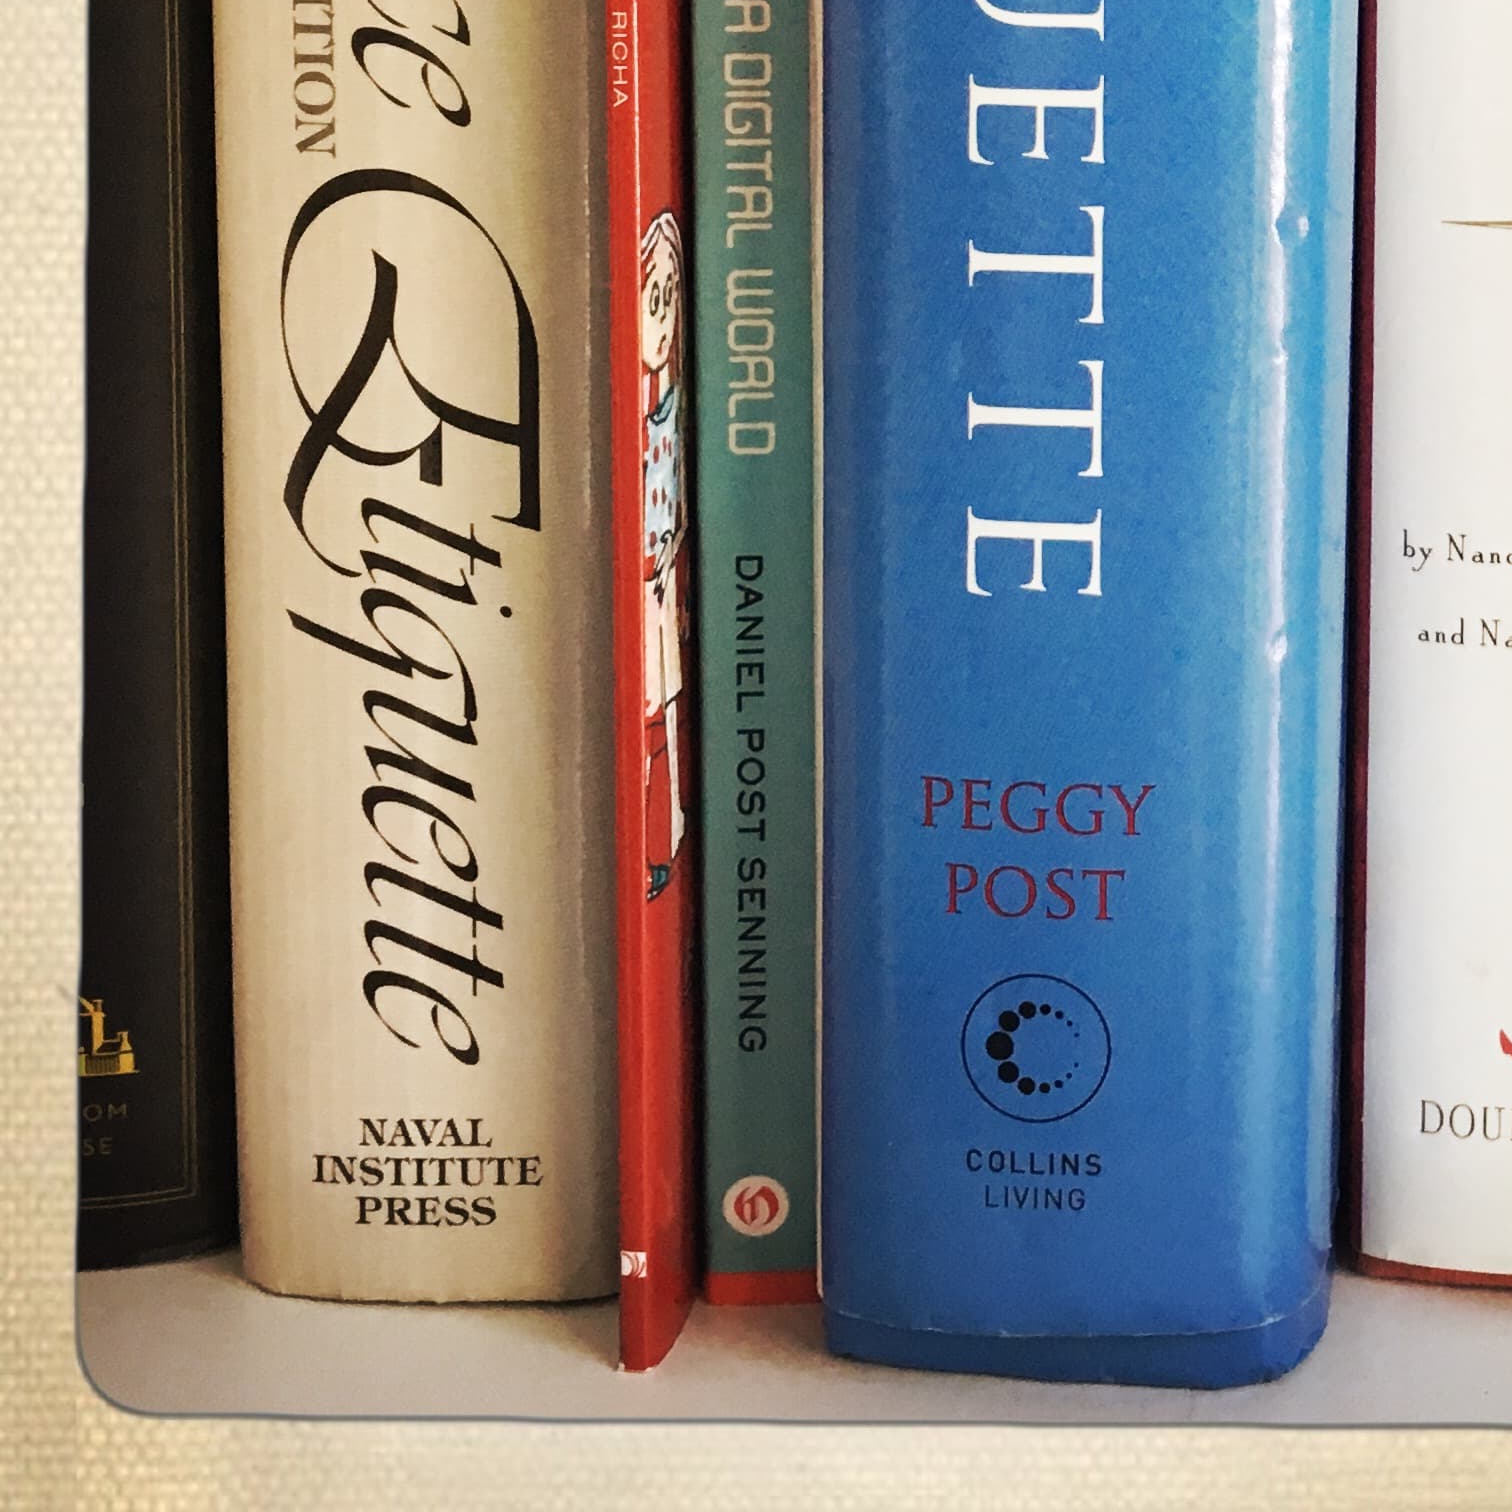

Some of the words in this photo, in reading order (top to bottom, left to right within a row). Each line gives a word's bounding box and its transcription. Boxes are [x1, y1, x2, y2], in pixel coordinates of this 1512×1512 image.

[611, 11, 630, 109] RICHA
[723, 52, 774, 250] DIGITAL
[726, 267, 777, 456] WORLD
[1401, 529, 1434, 573] by
[735, 554, 766, 713] DANIEL
[1416, 617, 1465, 646] and
[736, 728, 767, 842] POST
[920, 773, 1157, 837] PEGGY
[943, 861, 1126, 922] POST
[737, 855, 768, 1055] SENNING
[359, 1116, 494, 1150] NAVAL
[964, 1148, 1104, 1178] COLLINS
[312, 1153, 544, 1188] INSTITUTE
[983, 1184, 1088, 1212] LIVING
[354, 1194, 497, 1228] PRESS
